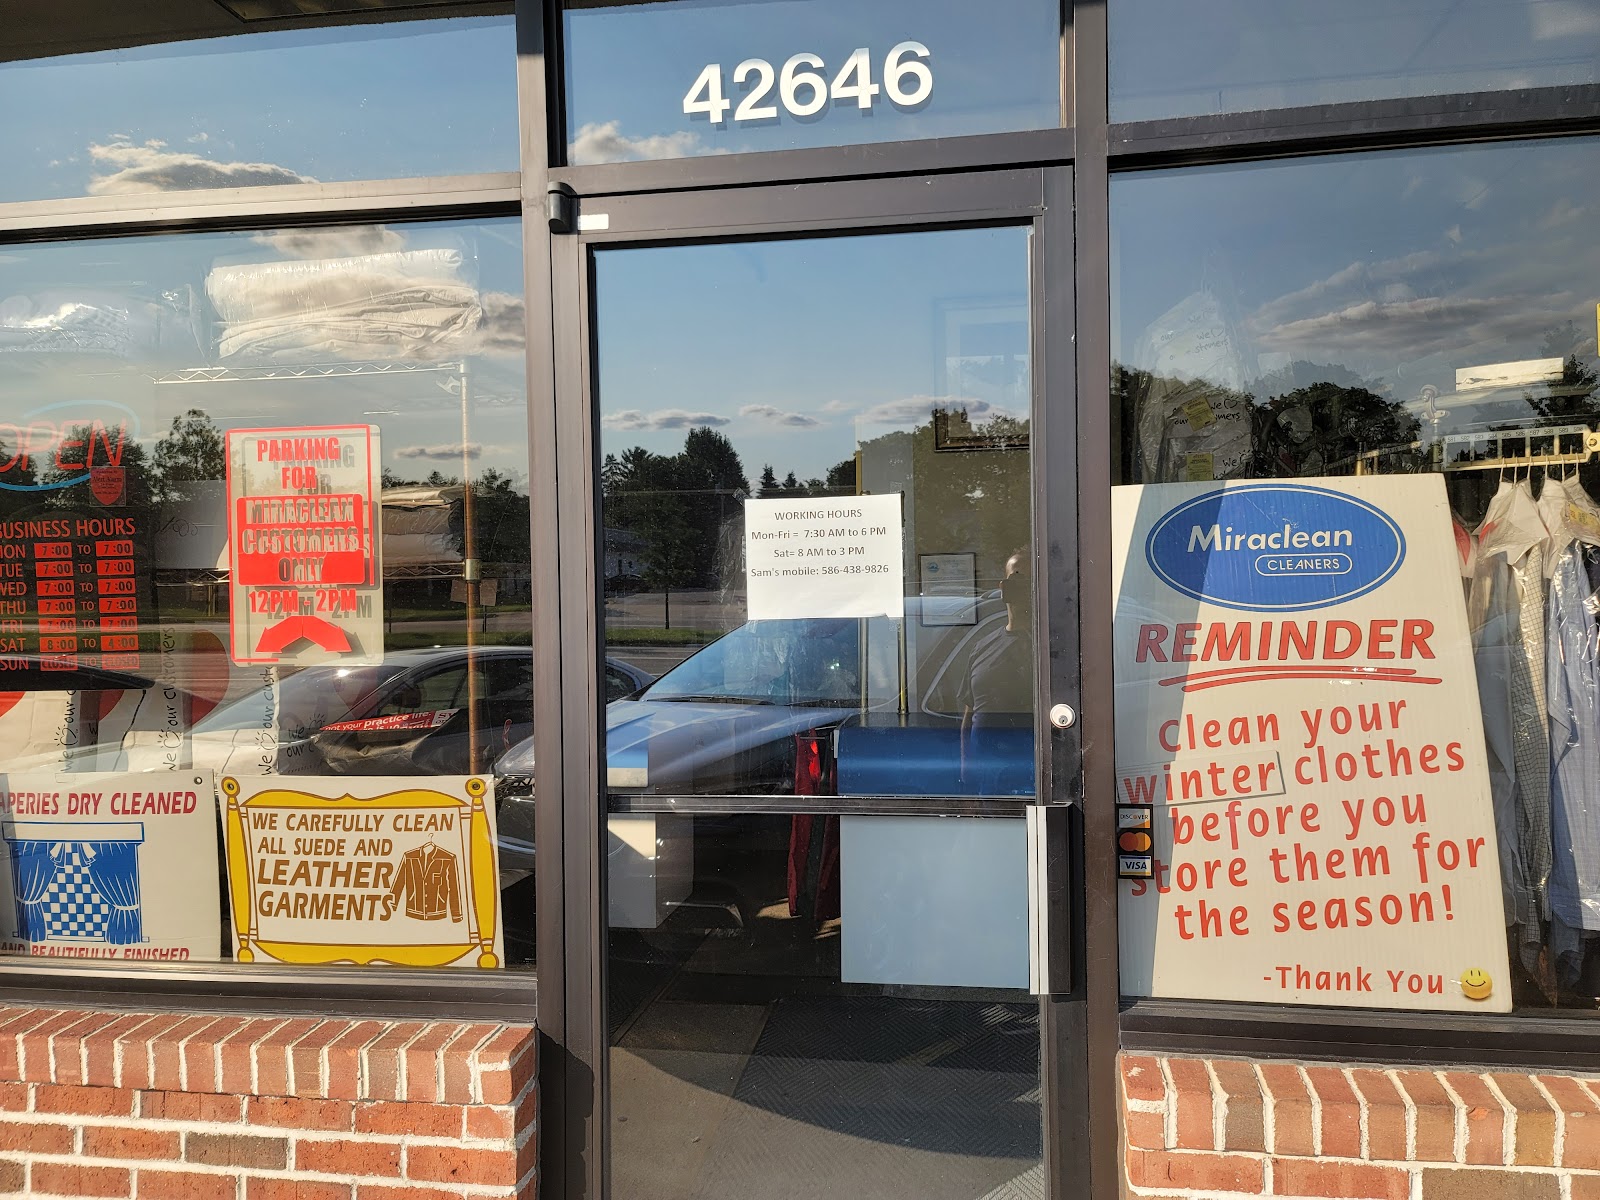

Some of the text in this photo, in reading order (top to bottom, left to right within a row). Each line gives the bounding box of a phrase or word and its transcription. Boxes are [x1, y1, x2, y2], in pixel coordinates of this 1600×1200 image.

[683, 40, 933, 123] 42646
[1197, 332, 1210, 340] We
[0, 419, 126, 472] OPEN
[257, 437, 340, 462] PARKING
[1223, 458, 1237, 467] We
[281, 467, 317, 490] FOR
[246, 496, 355, 525] MIRACLEAN
[774, 509, 862, 521] WORKING HOURS
[76, 518, 136, 536] HOURS
[751, 530, 790, 540] Mon-Fri
[804, 528, 825, 538] 7:30
[828, 528, 845, 538] AM
[848, 527, 858, 537] to
[861, 527, 867, 536] 6
[870, 526, 886, 536] PM
[242, 526, 360, 555] CUSTOMERS
[1187, 524, 1353, 552] Miraclean
[77, 545, 91, 555] TO
[774, 546, 865, 557] Sat= 8 AM to 3 PM
[0, 563, 23, 577] TUE
[78, 564, 92, 573] TO
[279, 557, 324, 583] ONLY
[751, 564, 889, 577] Sam's mobile: 586-438-9826
[1267, 558, 1340, 571] CLEANERS
[79, 583, 93, 592] TO
[0, 600, 26, 614] THU
[81, 601, 95, 611] TO
[248, 590, 299, 614] 12PM
[316, 588, 358, 613] 2PM
[0, 619, 23, 633] FRI
[81, 620, 96, 629] TO
[0, 638, 26, 652] SAT
[82, 639, 96, 648] TO
[1135, 619, 1436, 663] REMINDER
[0, 656, 138, 671] SUN CLOSED TO CLOSED
[64, 701, 75, 724] our
[165, 705, 179, 727] our
[263, 706, 275, 729] our
[342, 721, 362, 731] your
[363, 714, 409, 728] practice
[288, 724, 305, 739] We
[1300, 699, 1407, 748] your
[286, 743, 304, 758] our
[258, 755, 273, 776] We
[1123, 739, 1465, 804] winter clothes
[67, 792, 103, 815] DRY
[110, 791, 197, 815] CLEANED
[252, 813, 455, 832] WE CAREFULLY CLEAN
[1171, 794, 1427, 850] before you
[257, 837, 393, 857] ALL SUEDE AND
[257, 859, 394, 889] LEATHER
[1125, 861, 1147, 870] VISA
[1131, 831, 1485, 897] store them for
[258, 891, 394, 921] GARMENTS
[1175, 884, 1455, 940] the season!
[1263, 965, 1444, 994] -Thank You
